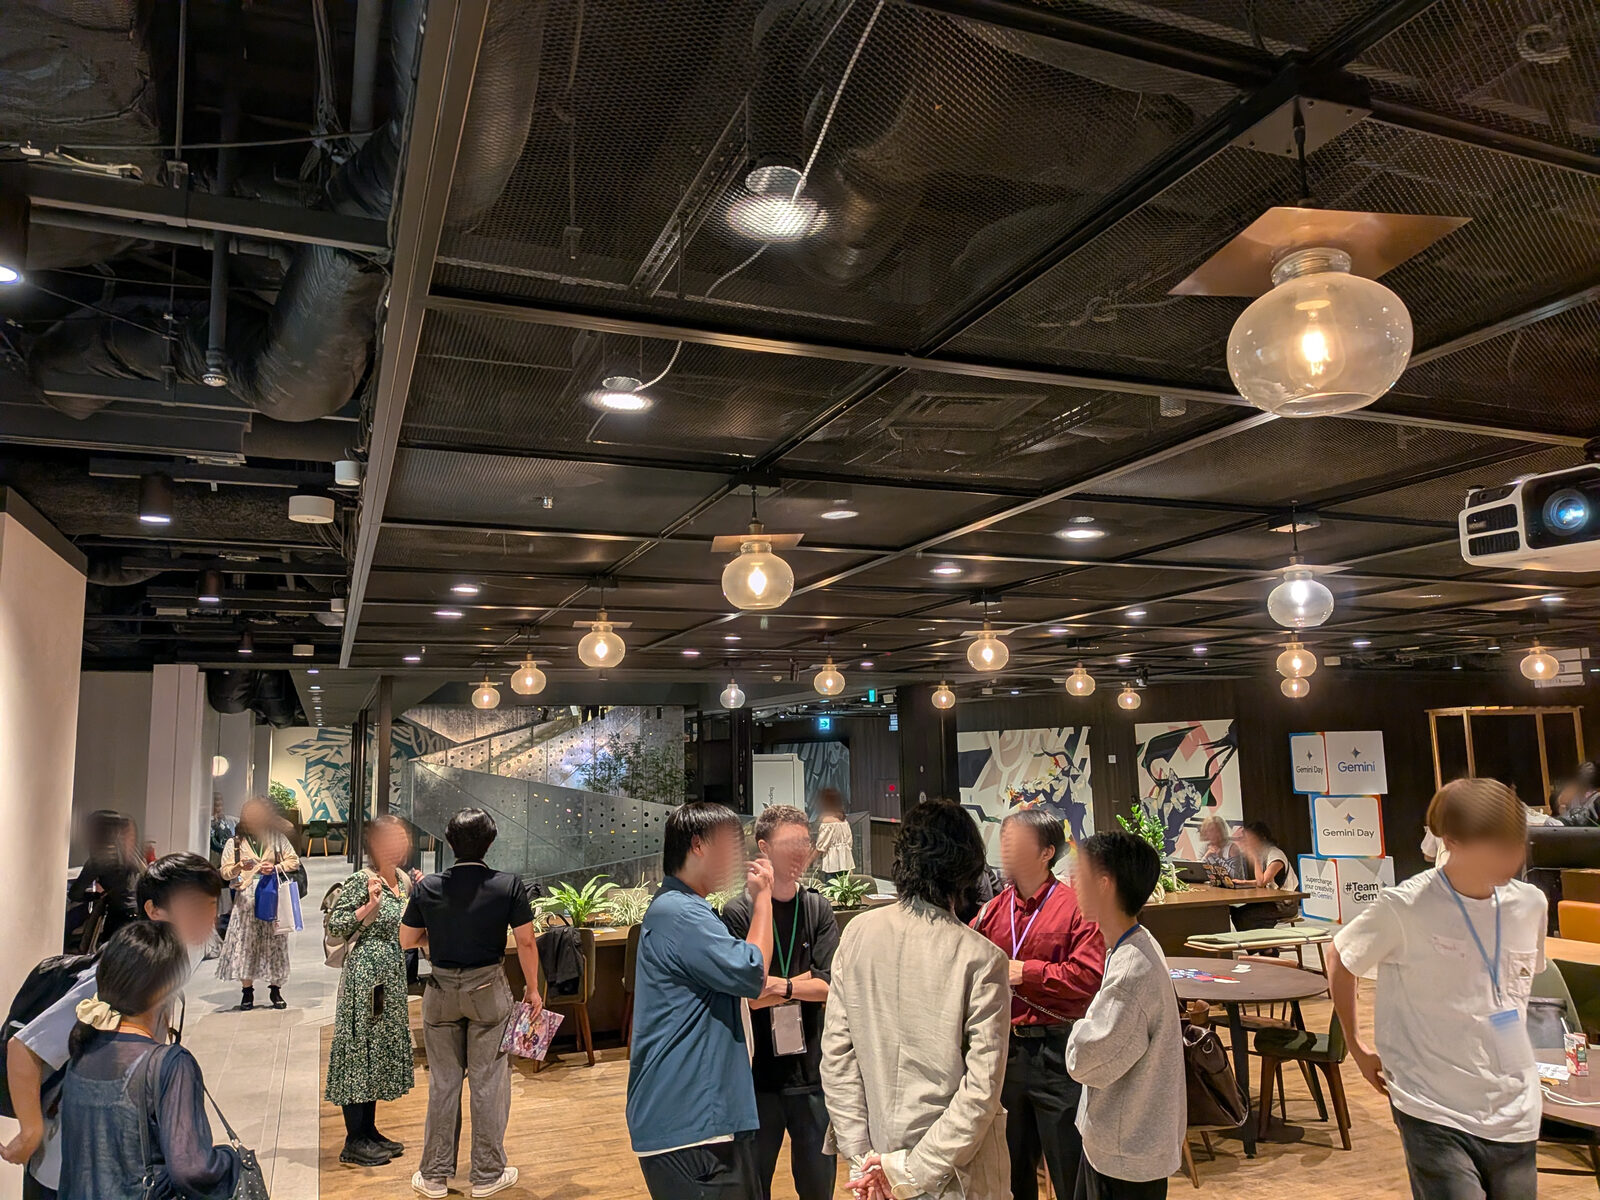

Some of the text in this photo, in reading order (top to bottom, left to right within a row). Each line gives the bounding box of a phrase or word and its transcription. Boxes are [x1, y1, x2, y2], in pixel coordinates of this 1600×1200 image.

[1314, 766, 1323, 775] Day
[1337, 761, 1376, 773] Gemini
[1322, 828, 1375, 838] Gemini Day
[1305, 875, 1333, 886] Supercharge
[1314, 885, 1335, 894] creativity
[1345, 882, 1379, 892] #Team
[1317, 892, 1333, 900] Gemini
[1353, 891, 1380, 901] Gem
